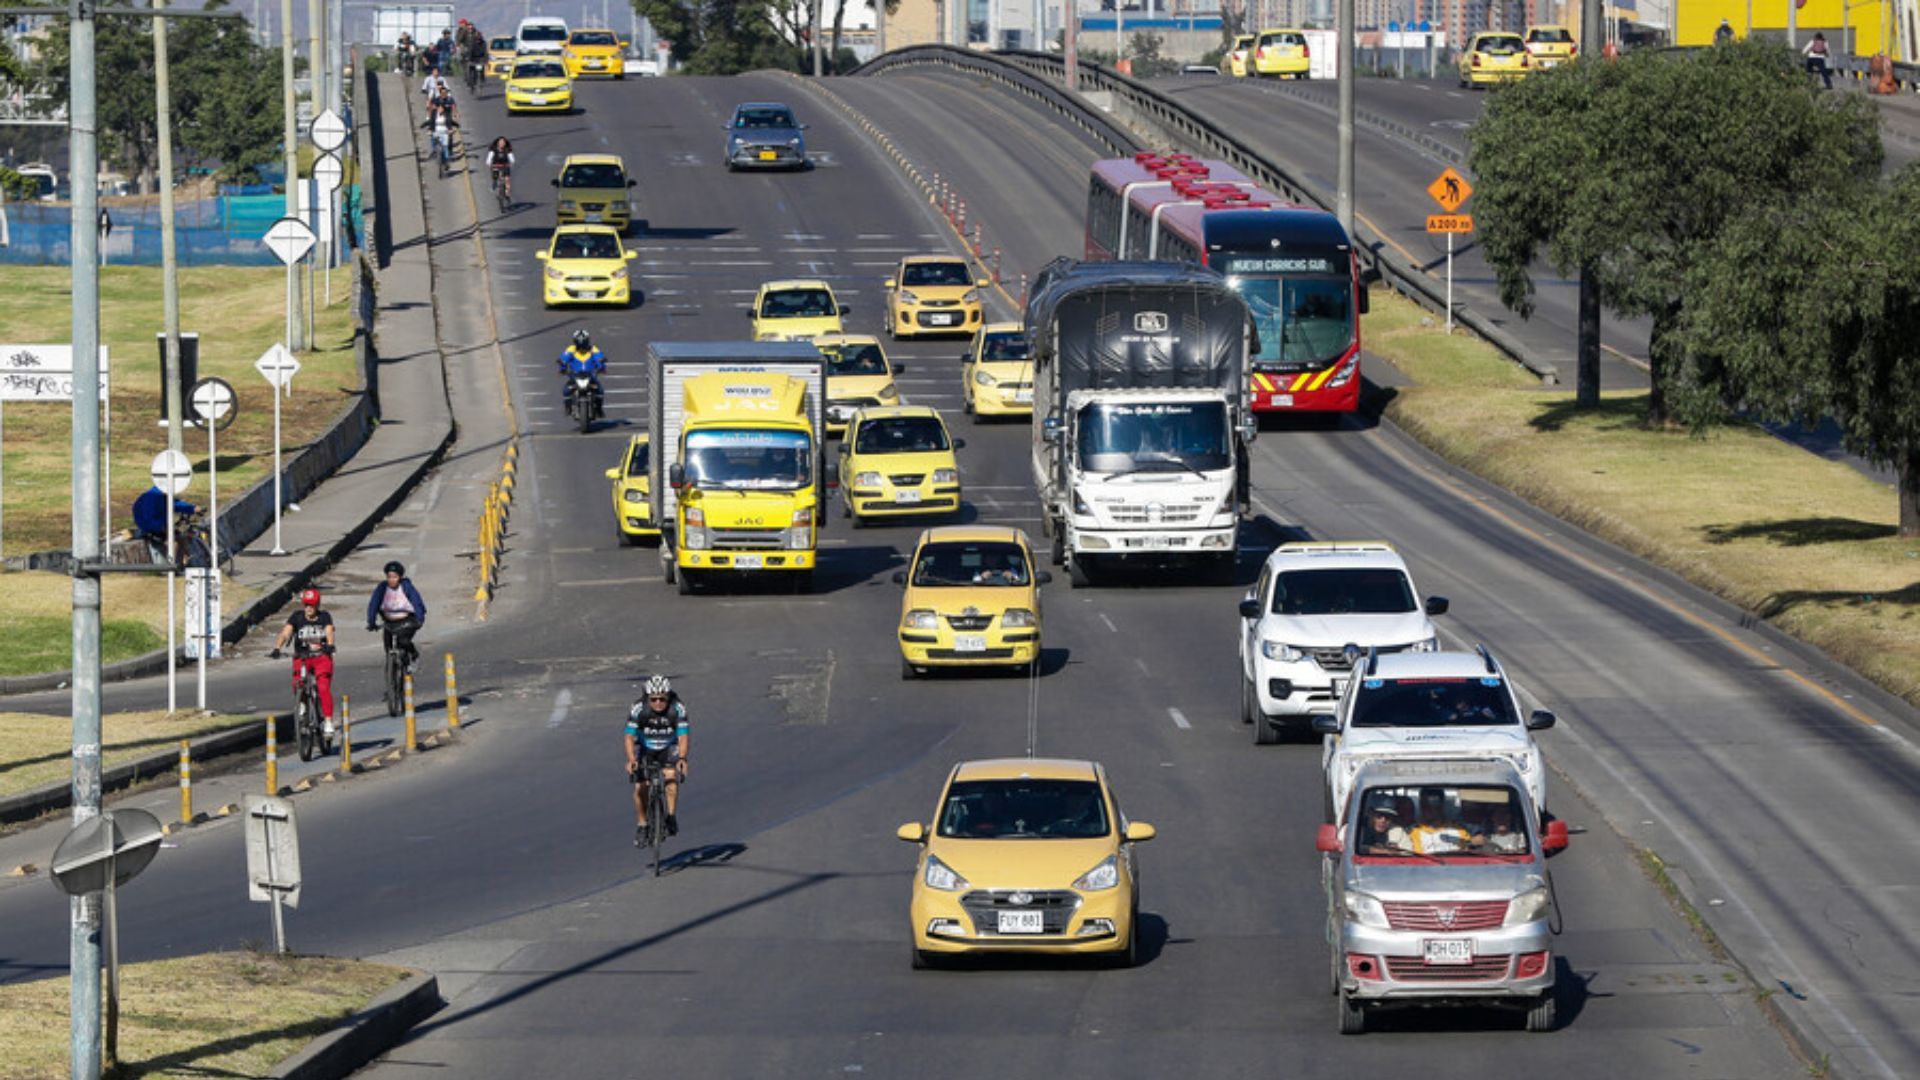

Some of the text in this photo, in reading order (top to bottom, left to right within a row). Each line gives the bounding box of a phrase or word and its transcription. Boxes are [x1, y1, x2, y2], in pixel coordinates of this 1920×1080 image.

[1438, 219, 1458, 229] 200
[1265, 259, 1306, 271] CARACAS
[713, 399, 780, 411] JAC
[734, 517, 764, 525] JAC
[1000, 914, 1040, 927] FUY 881
